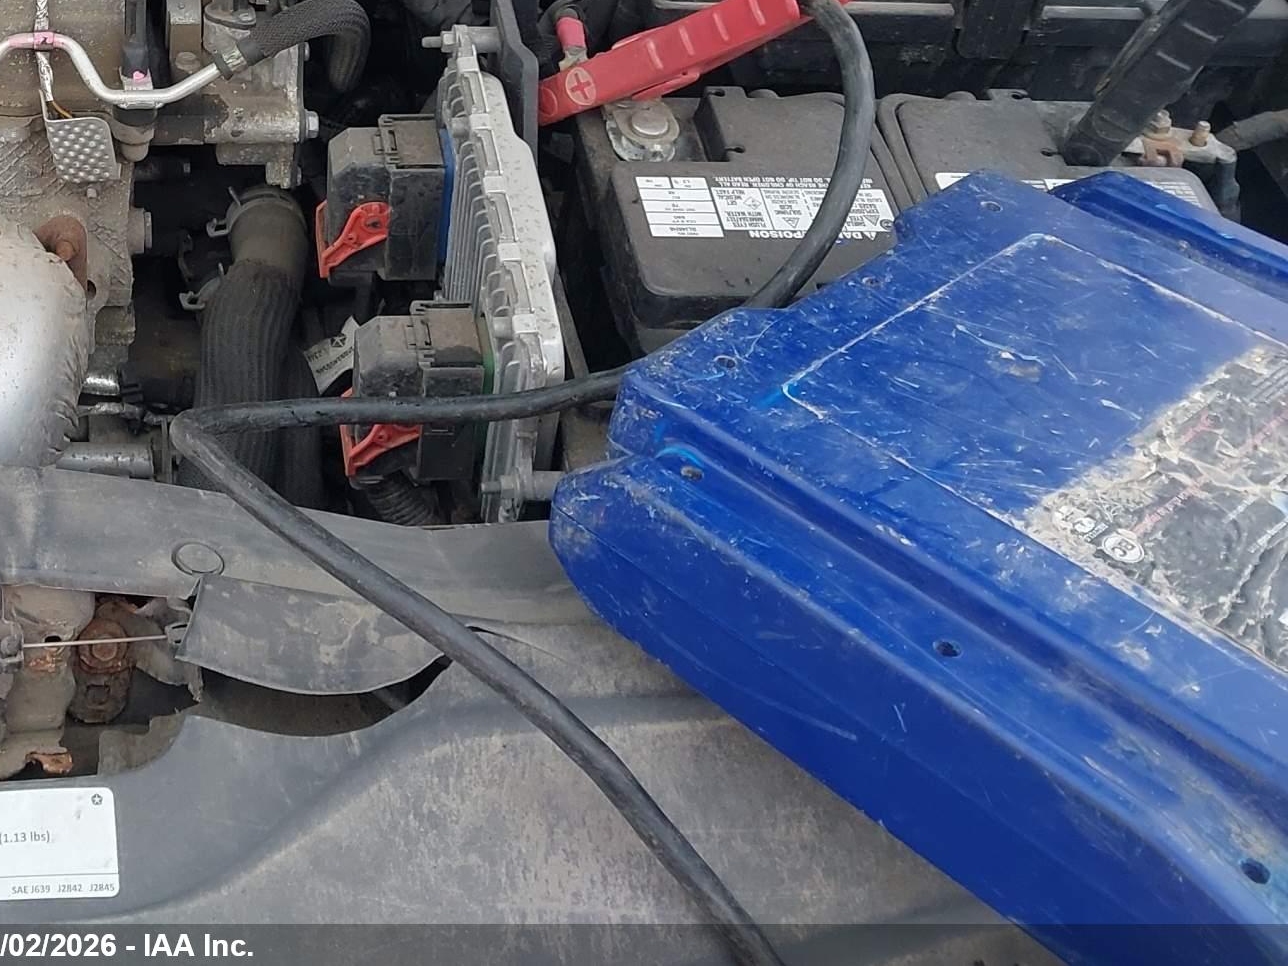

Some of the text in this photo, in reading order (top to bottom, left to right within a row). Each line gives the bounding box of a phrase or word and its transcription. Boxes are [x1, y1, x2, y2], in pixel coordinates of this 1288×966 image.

[30, 830, 51, 844] lbs)
[11, 885, 29, 895] SAE
[30, 884, 51, 894] J639
